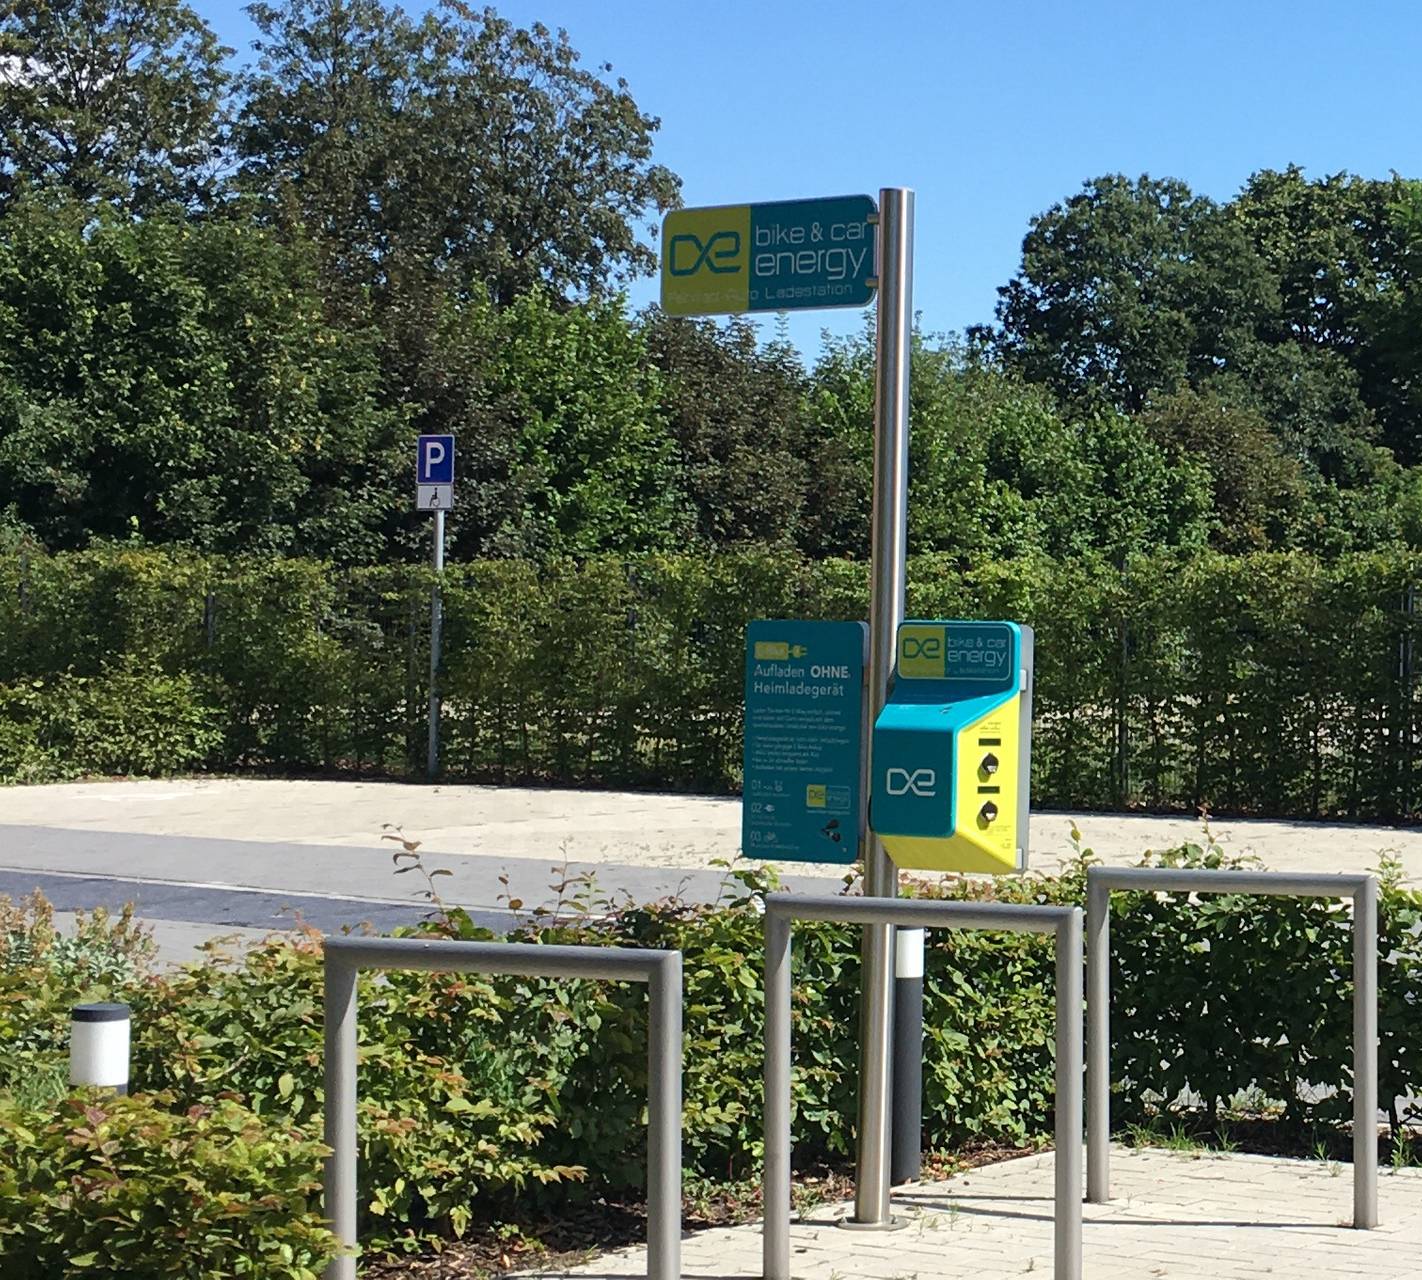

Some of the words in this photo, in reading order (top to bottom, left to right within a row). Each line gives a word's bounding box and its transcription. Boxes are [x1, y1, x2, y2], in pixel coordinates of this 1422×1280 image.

[755, 223, 804, 247] bike
[810, 221, 824, 243] &
[830, 221, 867, 242] car
[755, 247, 867, 280] energy
[764, 283, 853, 301] Ladestation
[425, 442, 445, 478] P
[947, 636, 973, 648] bike
[947, 650, 1007, 667] energy
[754, 663, 805, 678] Aufladen
[810, 665, 849, 679] OHNE
[753, 681, 844, 699] Heimladegerät
